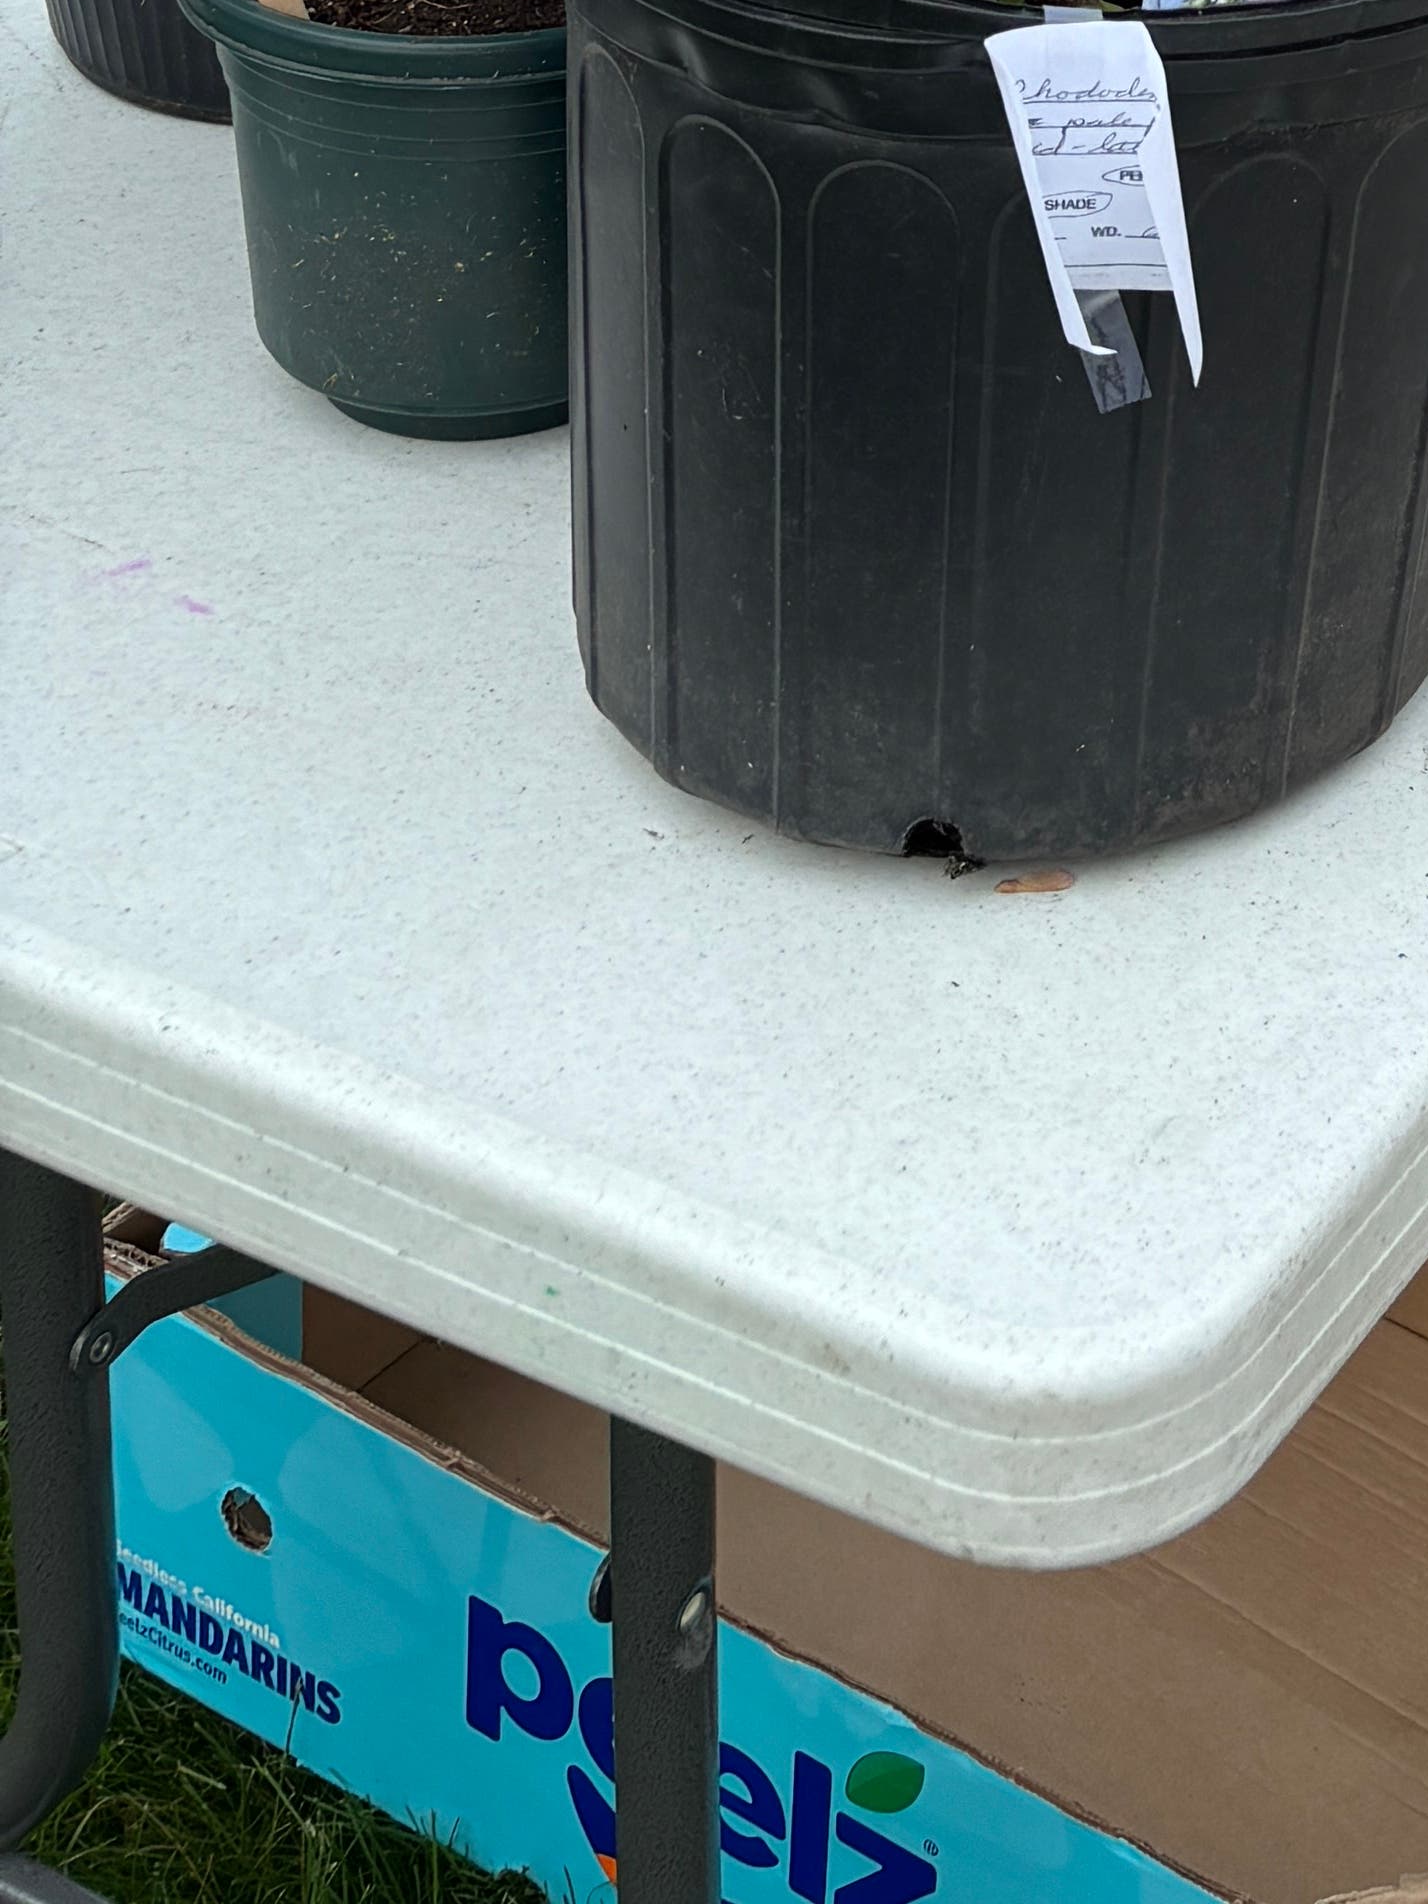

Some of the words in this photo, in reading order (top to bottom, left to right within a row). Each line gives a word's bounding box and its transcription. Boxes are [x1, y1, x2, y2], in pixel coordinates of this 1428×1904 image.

[1043, 198, 1097, 212] SHADE
[1090, 225, 1122, 238] WD.
[116, 1561, 342, 1726] MANDARINS
[119, 1611, 229, 1686] eelzCitrus.com
[191, 1585, 281, 1650] California
